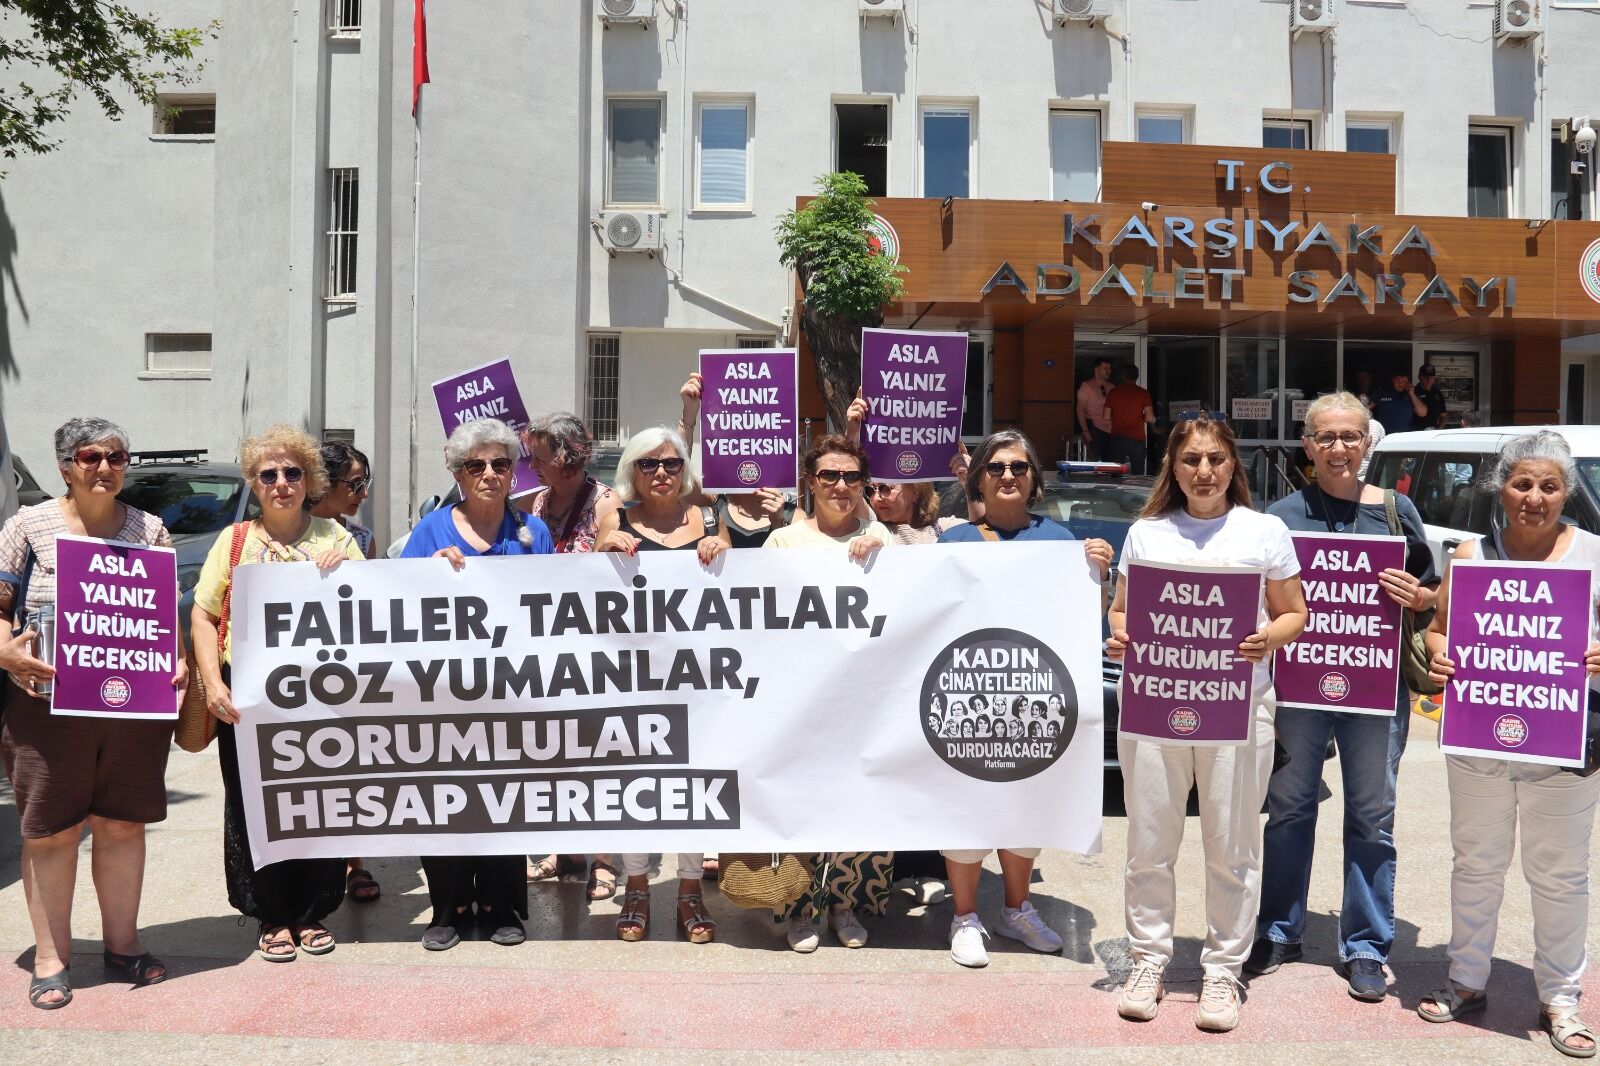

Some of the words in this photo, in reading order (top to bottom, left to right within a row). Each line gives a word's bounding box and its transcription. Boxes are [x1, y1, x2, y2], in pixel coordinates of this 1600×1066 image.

[1063, 213, 1438, 258] KARŞIYAKA
[980, 260, 1245, 300] ADALET
[1287, 270, 1516, 308] SARAYI
[888, 343, 939, 364] ASLA
[724, 362, 772, 380] ASLA
[880, 370, 946, 392] YALNIZ
[456, 376, 495, 403] ASLA
[717, 387, 779, 405] YALNIZ
[454, 396, 510, 423] YALNIZ
[706, 410, 791, 431] YÜRÜME-
[867, 395, 957, 419] YÜRÜME-
[705, 436, 793, 456] YECEKSİN
[865, 423, 957, 446] YECEKSİN
[88, 553, 148, 579] ASLA
[1310, 549, 1372, 573] ASLA
[79, 581, 157, 610] YALNIZ
[1159, 581, 1225, 607] ASLA
[1300, 580, 1380, 605] YALNIZ
[1485, 579, 1553, 604] ASLA
[264, 584, 508, 648] FAİLLER,
[520, 574, 887, 638] TARİKATLAR,
[1303, 608, 1393, 637] ÜRÜME-
[64, 609, 171, 641] YÜRÜME-
[1148, 612, 1233, 639] YALNIZ
[1474, 613, 1563, 640] YALNIZ
[61, 643, 172, 673] YECEKSİN
[953, 648, 1039, 669] KADIN
[1132, 640, 1248, 671] YÜRÜME-
[1283, 642, 1393, 669] YECEKSİN
[1455, 642, 1579, 676] YÜRÜME-
[265, 648, 394, 709] GÖZ
[406, 647, 760, 702] YUMANLAR,
[939, 668, 1053, 691] CİNAYETLERİNİ
[1128, 673, 1246, 701] YECEKSİN
[1452, 679, 1579, 712] YECEKSİN
[271, 713, 673, 772] SORUMLULAR
[947, 739, 1053, 759] DURDURACAĞIZ
[984, 760, 1016, 769] Platformu
[276, 783, 468, 832] HESAP
[476, 777, 730, 824] VERECEK
